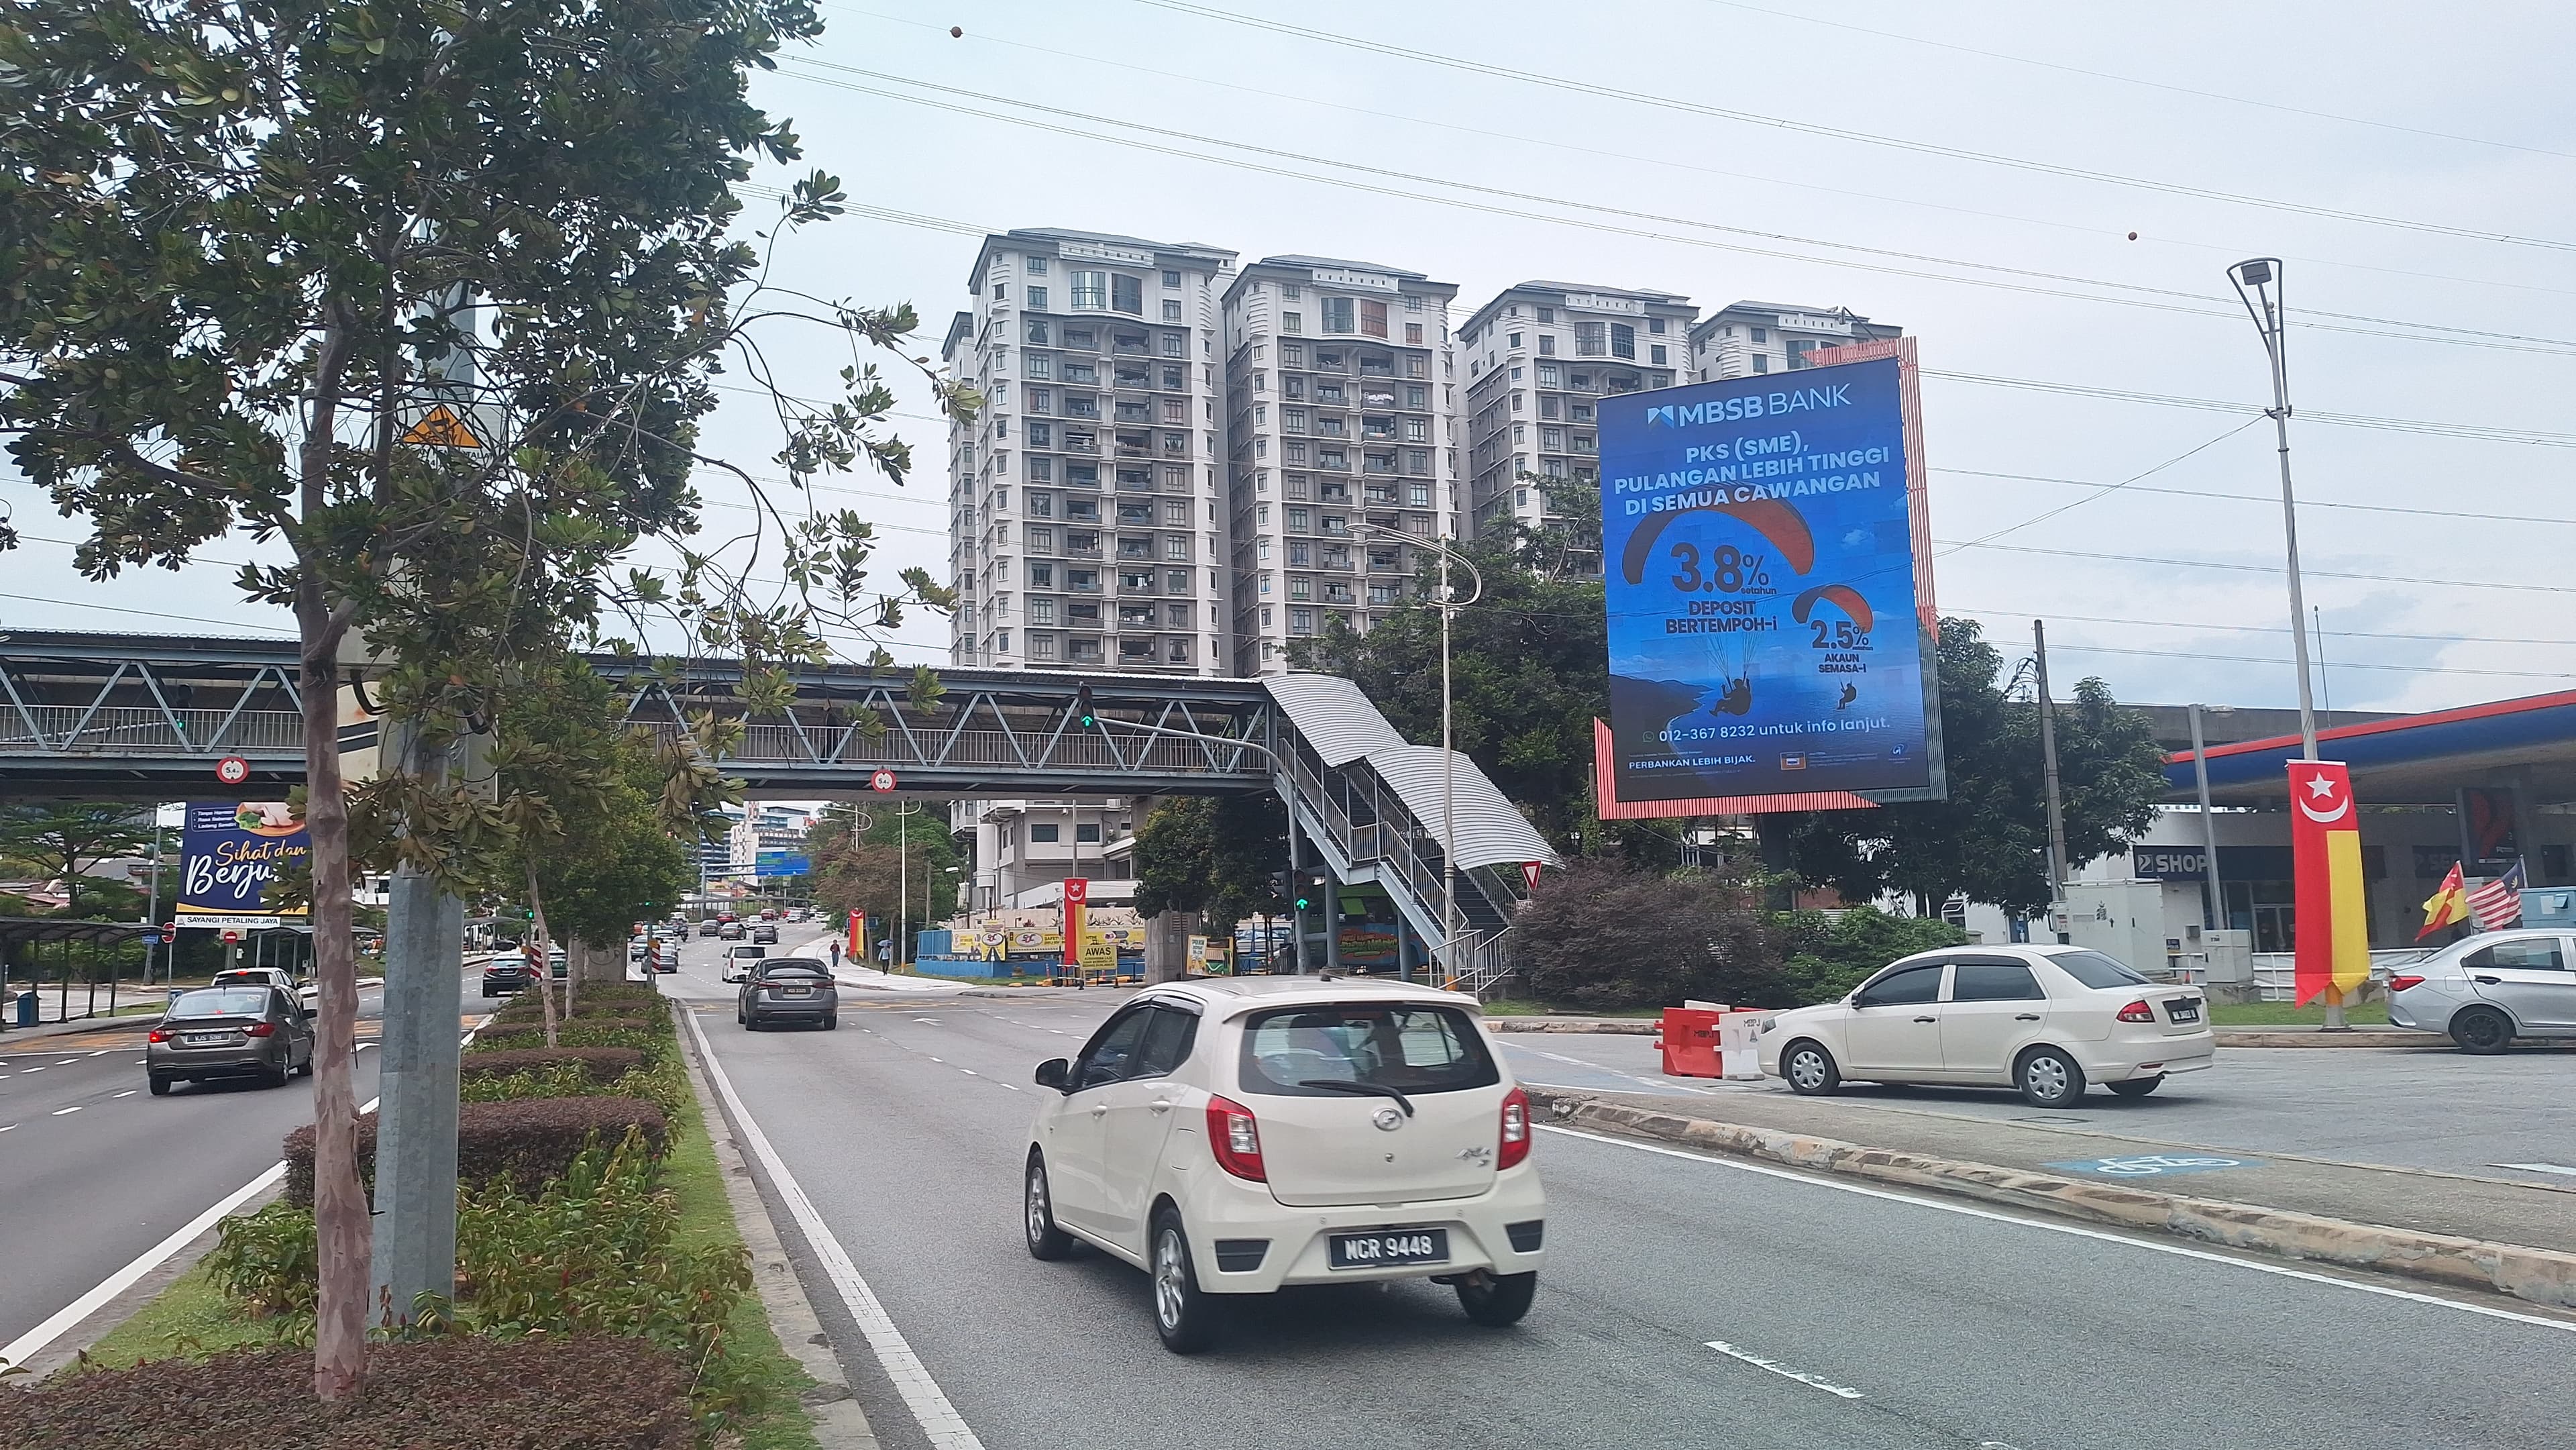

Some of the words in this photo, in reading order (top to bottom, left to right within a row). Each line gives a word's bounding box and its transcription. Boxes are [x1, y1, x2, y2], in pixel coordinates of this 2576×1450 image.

[1678, 395, 1764, 427] MBSB
[1769, 382, 1852, 415] BANK
[1686, 442, 1729, 464] PKS
[1734, 430, 1810, 462] (SME),
[1614, 466, 1737, 495] PULANGAN
[1741, 456, 1803, 480] LEBIH
[1807, 446, 1890, 471] TINGGI
[1625, 497, 1647, 516] DI
[1652, 488, 1729, 512] SEMUA
[1734, 471, 1881, 504] CAWANGAN
[1670, 541, 1770, 593] 3.8%
[1688, 601, 1756, 616] DEPOSIT
[1665, 615, 1778, 634] BERTEMPOH-i
[1810, 619, 1870, 650] 2.5%
[1824, 653, 1860, 663] AKAUN
[1658, 727, 1716, 742] 012-367
[1719, 725, 1756, 738] 8232
[1758, 721, 1804, 735] untuk
[1807, 719, 1837, 733] info
[1840, 717, 1890, 733] lanjut.
[1628, 758, 1690, 770] PERBANKAN
[1693, 756, 1722, 766] LEBIH
[1724, 754, 1756, 765] BIJAK.
[215, 839, 276, 867] Sihat
[274, 839, 307, 858] dan
[2155, 853, 2207, 873] SHOP
[186, 916, 220, 924] SAYANGI
[221, 917, 260, 925] PETALING
[1085, 947, 1112, 956] AWAS
[1743, 1018, 1760, 1027] MBPJ
[1344, 1238, 1382, 1260] NCR
[1385, 1235, 1434, 1257] 9448
